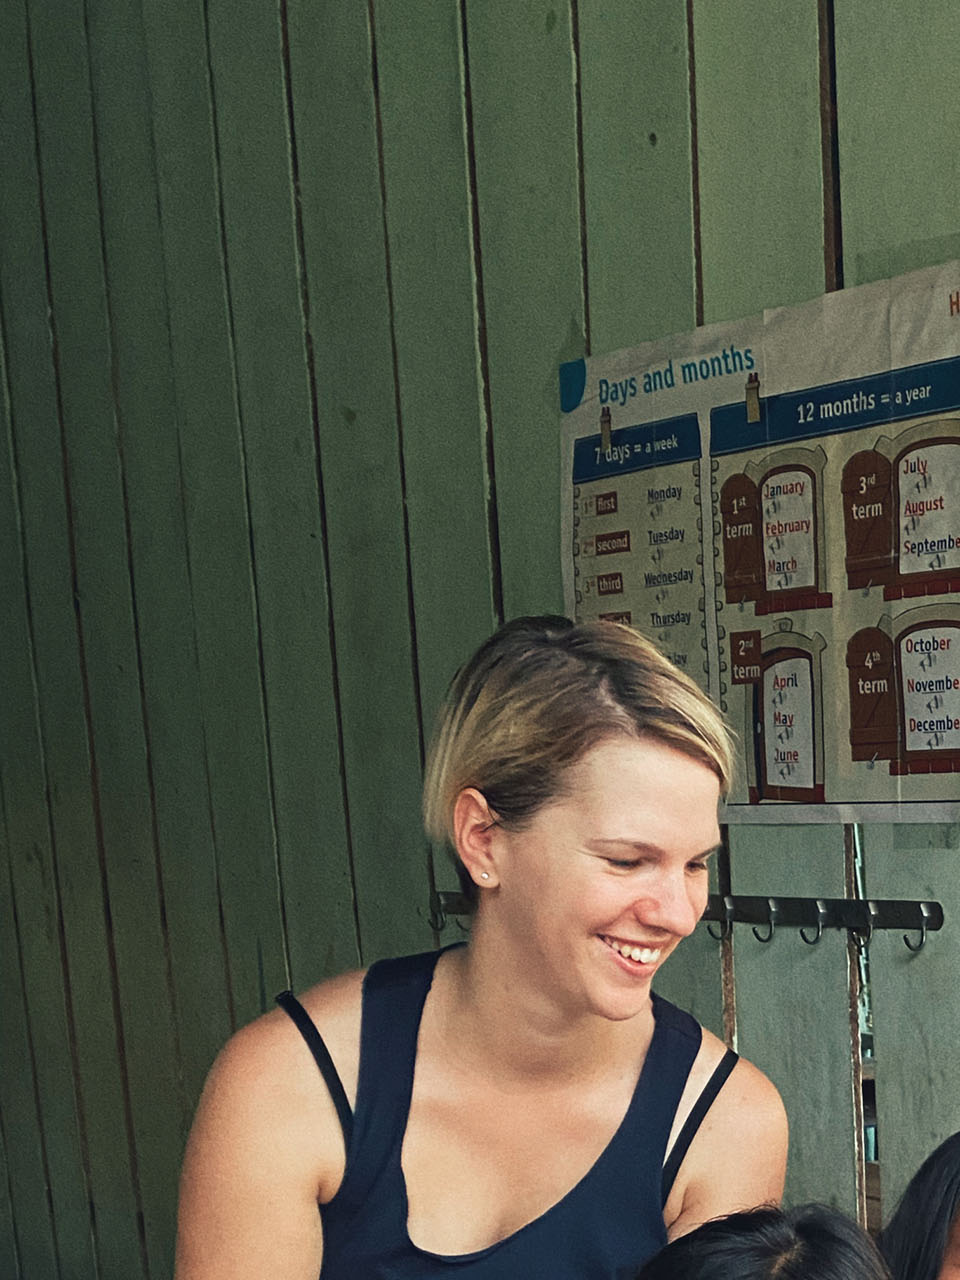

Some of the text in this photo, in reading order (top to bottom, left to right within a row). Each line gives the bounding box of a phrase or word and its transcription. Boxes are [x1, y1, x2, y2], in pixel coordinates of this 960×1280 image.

[599, 344, 755, 406] Days and months
[797, 402, 815, 424] 12
[819, 391, 876, 419] months
[895, 392, 902, 404] a
[905, 384, 932, 406] year
[594, 447, 602, 465] 7
[605, 443, 630, 464] days
[645, 443, 651, 453] a
[654, 434, 678, 451] week
[903, 456, 928, 475] July
[764, 480, 805, 498] January
[859, 473, 876, 494] 3rd
[647, 485, 682, 502] Monday
[732, 495, 747, 515] 1st
[852, 502, 882, 520] term
[904, 496, 944, 517] August
[648, 527, 685, 543] Tuesday
[726, 523, 753, 539] term
[766, 519, 811, 535] February
[596, 534, 628, 551] second
[768, 557, 797, 573] March
[599, 577, 622, 592] third
[644, 568, 694, 586] Wednesday
[650, 611, 691, 627] Thursday
[905, 636, 952, 653] October
[864, 651, 881, 670] 4th
[733, 664, 761, 679] term
[773, 672, 798, 690] April
[858, 678, 888, 694] term
[774, 711, 794, 728] May
[774, 747, 799, 762] June
